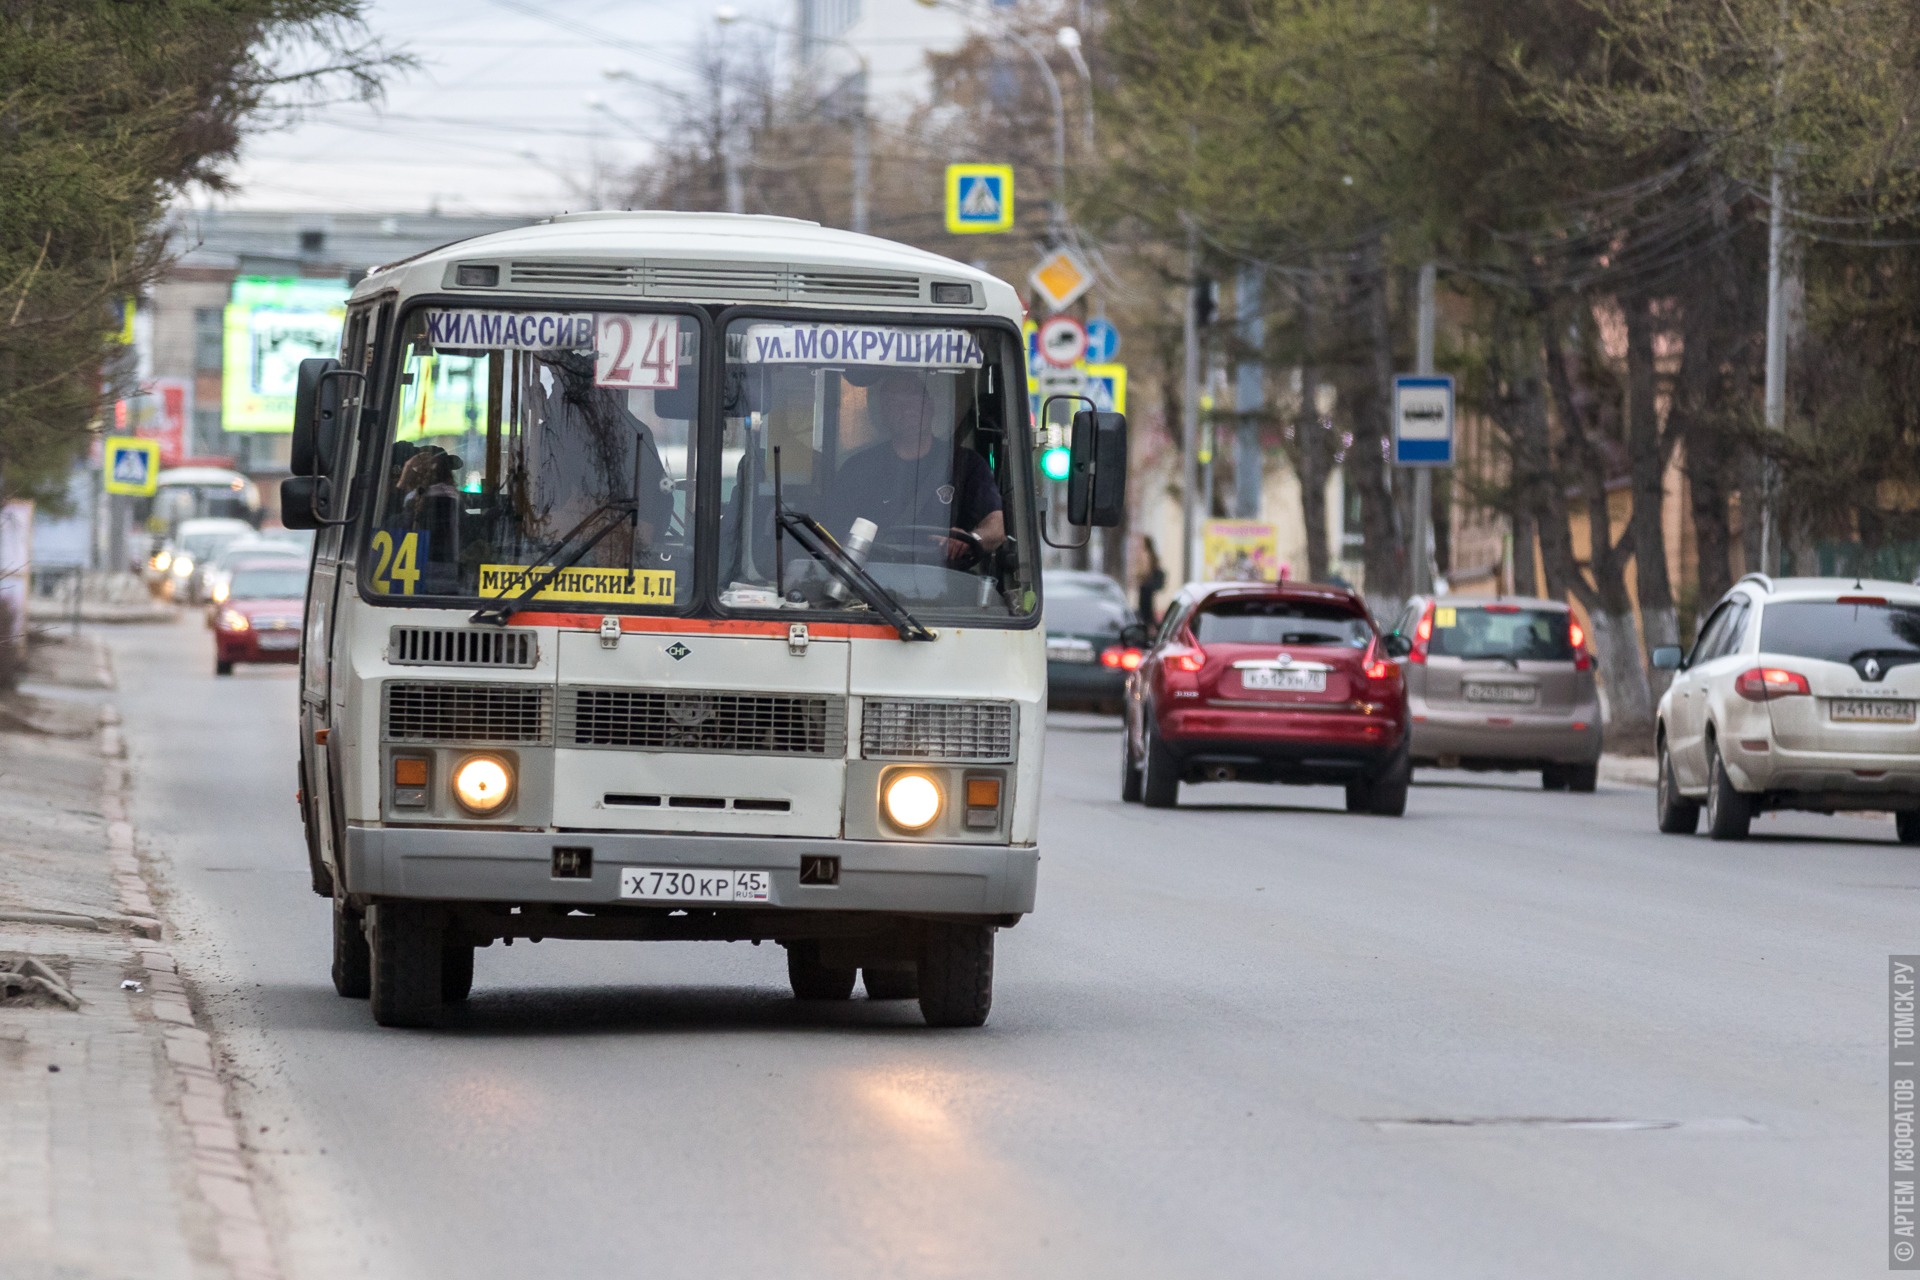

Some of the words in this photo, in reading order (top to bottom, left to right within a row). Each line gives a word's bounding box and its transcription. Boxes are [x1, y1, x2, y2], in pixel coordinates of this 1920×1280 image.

[426, 311, 593, 347] ЖИЛМАССИВ
[603, 314, 675, 386] 24
[371, 530, 420, 596] 24
[736, 891, 754, 899] RUS
[737, 873, 761, 891] 45
